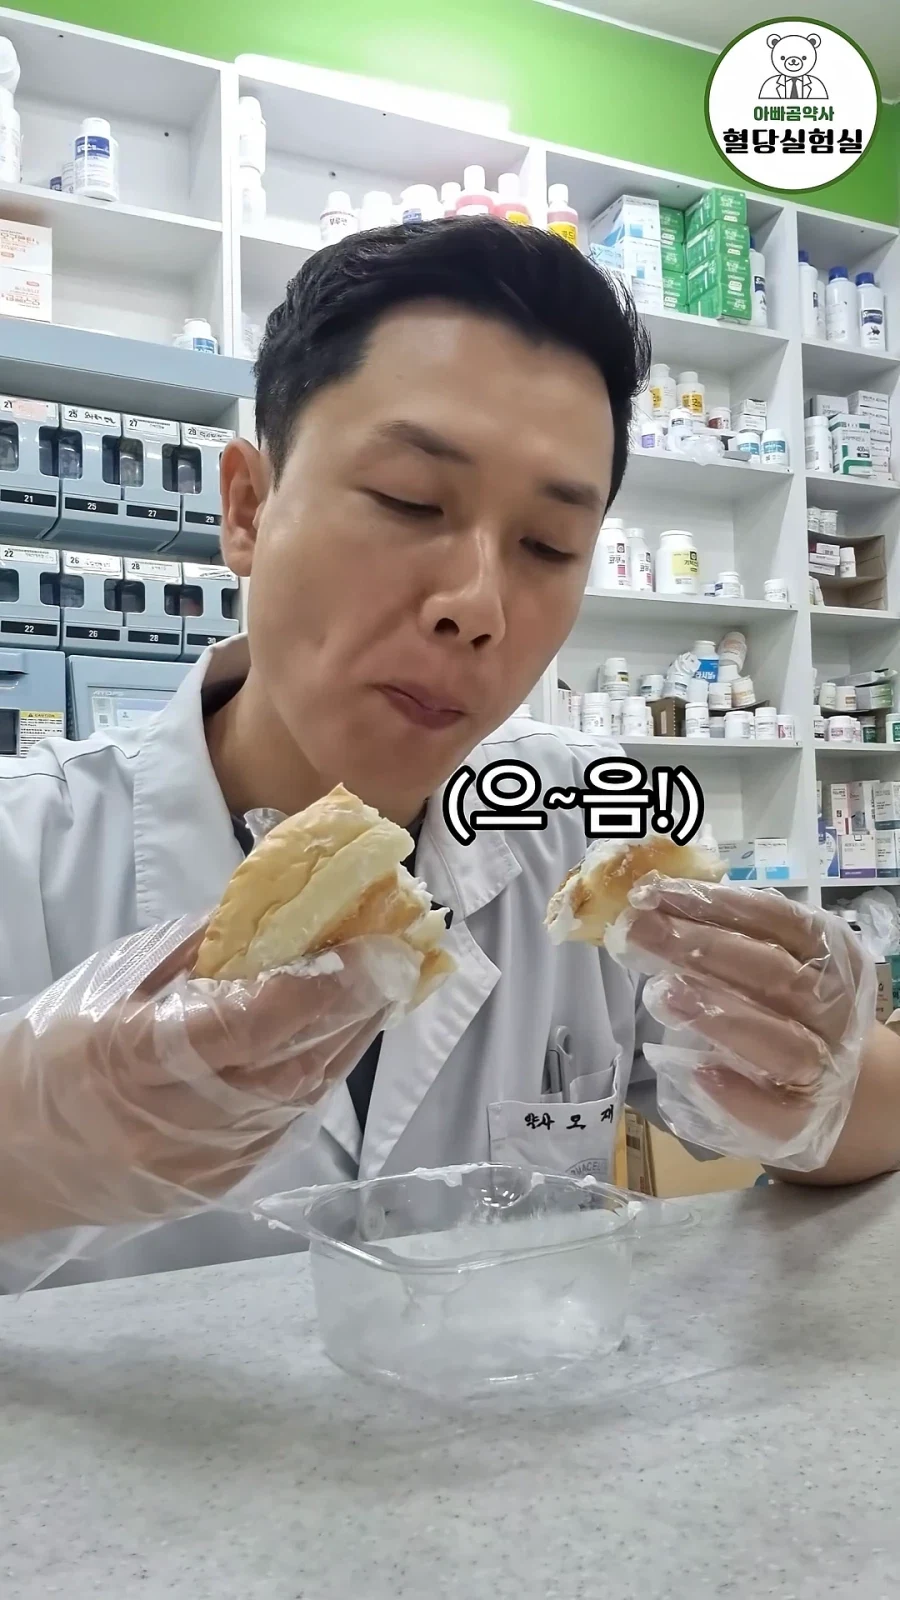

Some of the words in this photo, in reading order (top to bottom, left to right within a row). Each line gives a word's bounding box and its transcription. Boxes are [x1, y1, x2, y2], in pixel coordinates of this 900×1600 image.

[4, 400, 13, 409] 21
[68, 409, 78, 418] 25
[129, 419, 138, 427] 27
[24, 494, 33, 503] 21
[87, 502, 97, 511] 25
[147, 509, 157, 518] 27
[205, 515, 215, 524] 29
[4, 550, 14, 558] 22
[70, 556, 80, 564] 26
[131, 562, 141, 570] 28
[24, 625, 35, 634] 22
[88, 629, 98, 638] 26
[149, 634, 159, 643] 28
[207, 637, 217, 645] 30
[524, 1112, 555, 1130] 약사
[566, 1114, 587, 1130] 오
